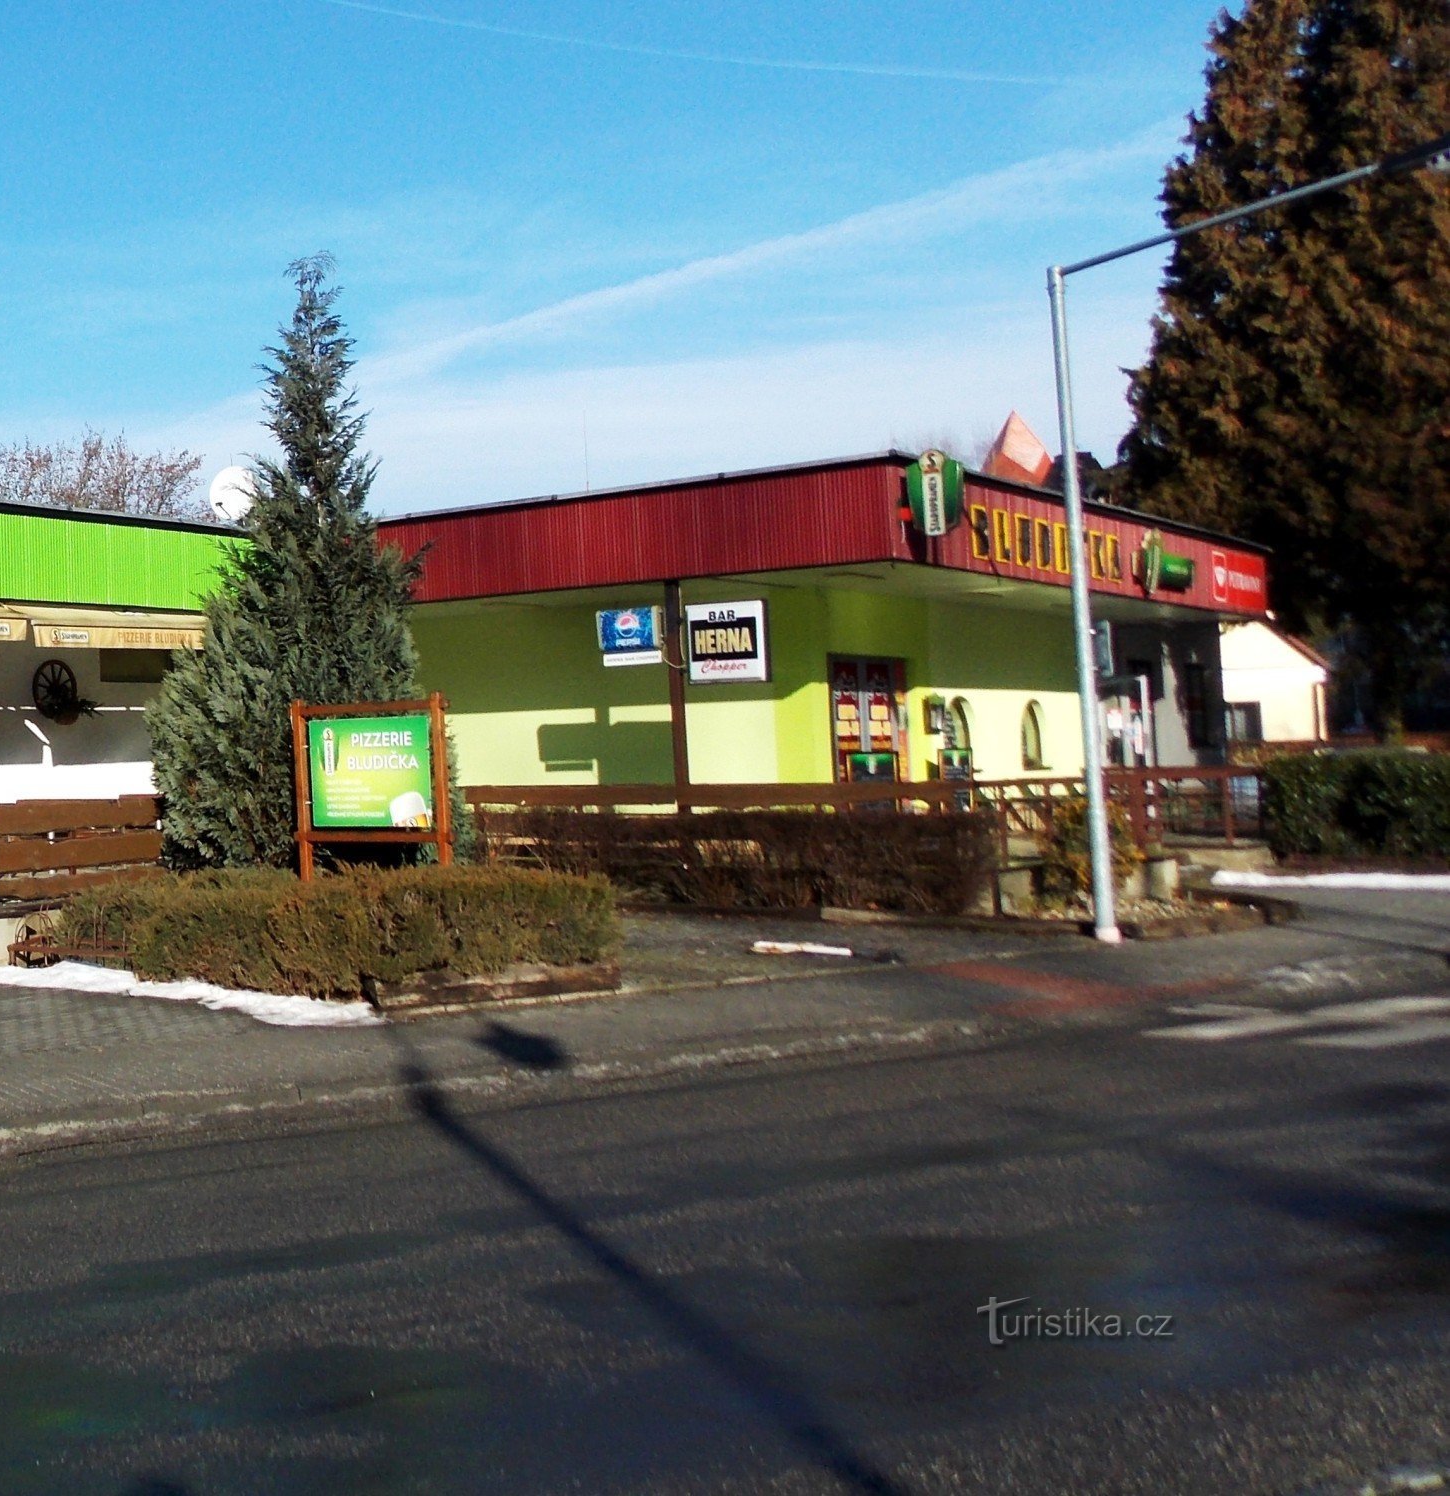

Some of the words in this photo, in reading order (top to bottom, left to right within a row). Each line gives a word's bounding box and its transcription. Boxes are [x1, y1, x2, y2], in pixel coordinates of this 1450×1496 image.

[970, 504, 1122, 584] BLUDIKA
[708, 609, 737, 622] BAR
[117, 631, 152, 644] PIZZERIE
[694, 627, 754, 655] HERNA
[701, 659, 749, 674] Chopper
[351, 731, 413, 748] PIZZERIE
[347, 752, 420, 771] BLUDIČKA
